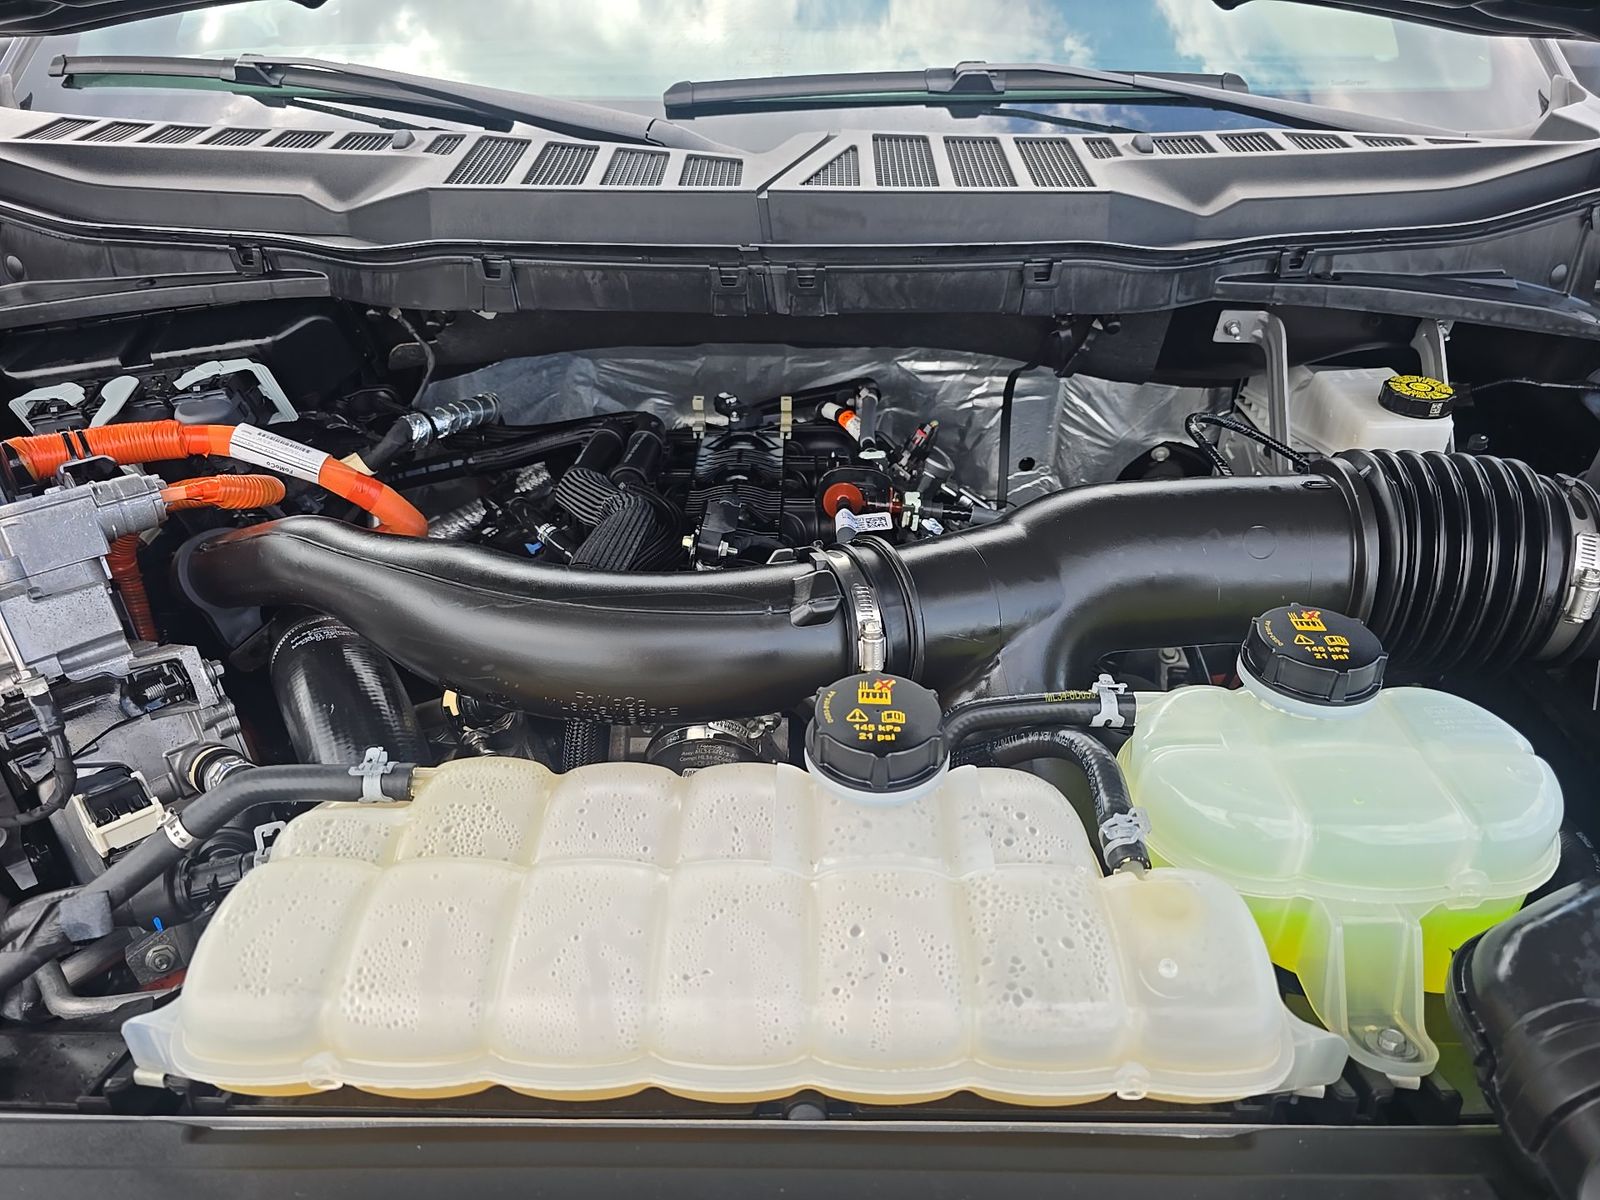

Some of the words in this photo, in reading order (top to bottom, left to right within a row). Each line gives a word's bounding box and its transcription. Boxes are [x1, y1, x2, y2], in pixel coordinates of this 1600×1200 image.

[266, 461, 294, 475] FoMoCo
[1327, 646, 1350, 654] kPa
[1331, 653, 1349, 661] psi
[853, 724, 876, 732] 145
[878, 724, 902, 733] kPa
[858, 732, 873, 740] 21
[877, 733, 896, 742] psi
